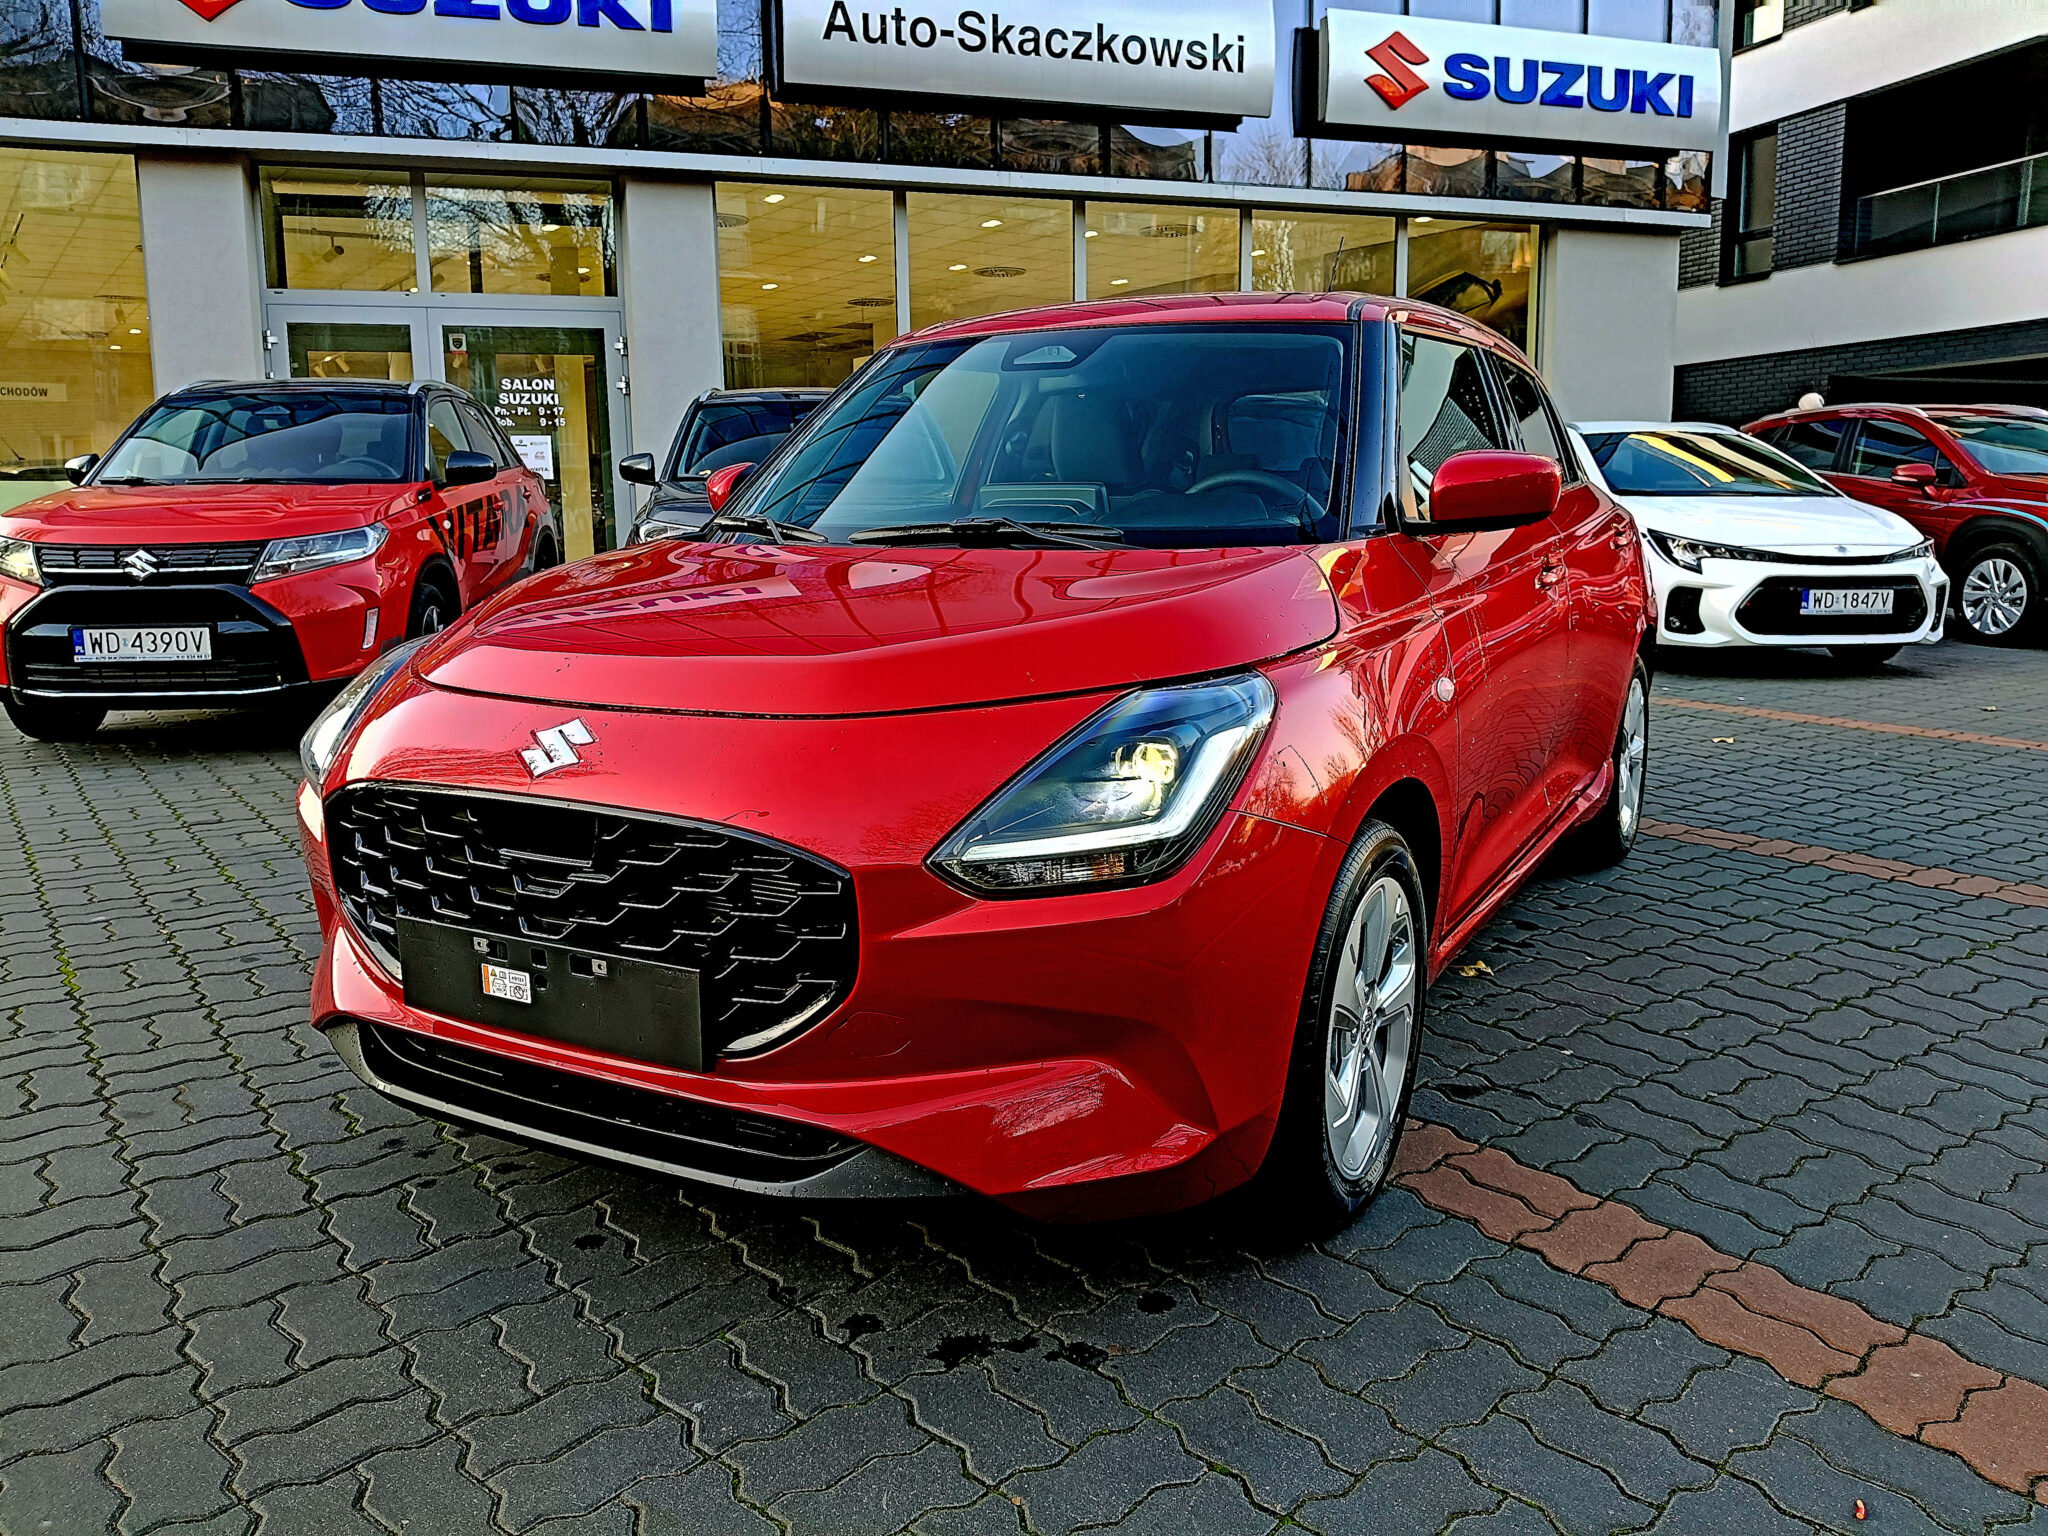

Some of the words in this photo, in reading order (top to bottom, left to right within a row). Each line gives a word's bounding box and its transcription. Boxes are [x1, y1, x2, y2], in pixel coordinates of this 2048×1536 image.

[822, 0, 1245, 74] Auto-Skaczkowski
[1442, 52, 1694, 119] SUZUKI
[501, 378, 555, 390] SALON
[498, 393, 559, 405] SUZUKI
[1813, 592, 1834, 608] WD
[1842, 592, 1890, 608] 1847V
[75, 645, 84, 653] PL
[88, 632, 120, 654] WD
[131, 631, 203, 653] 4390V
